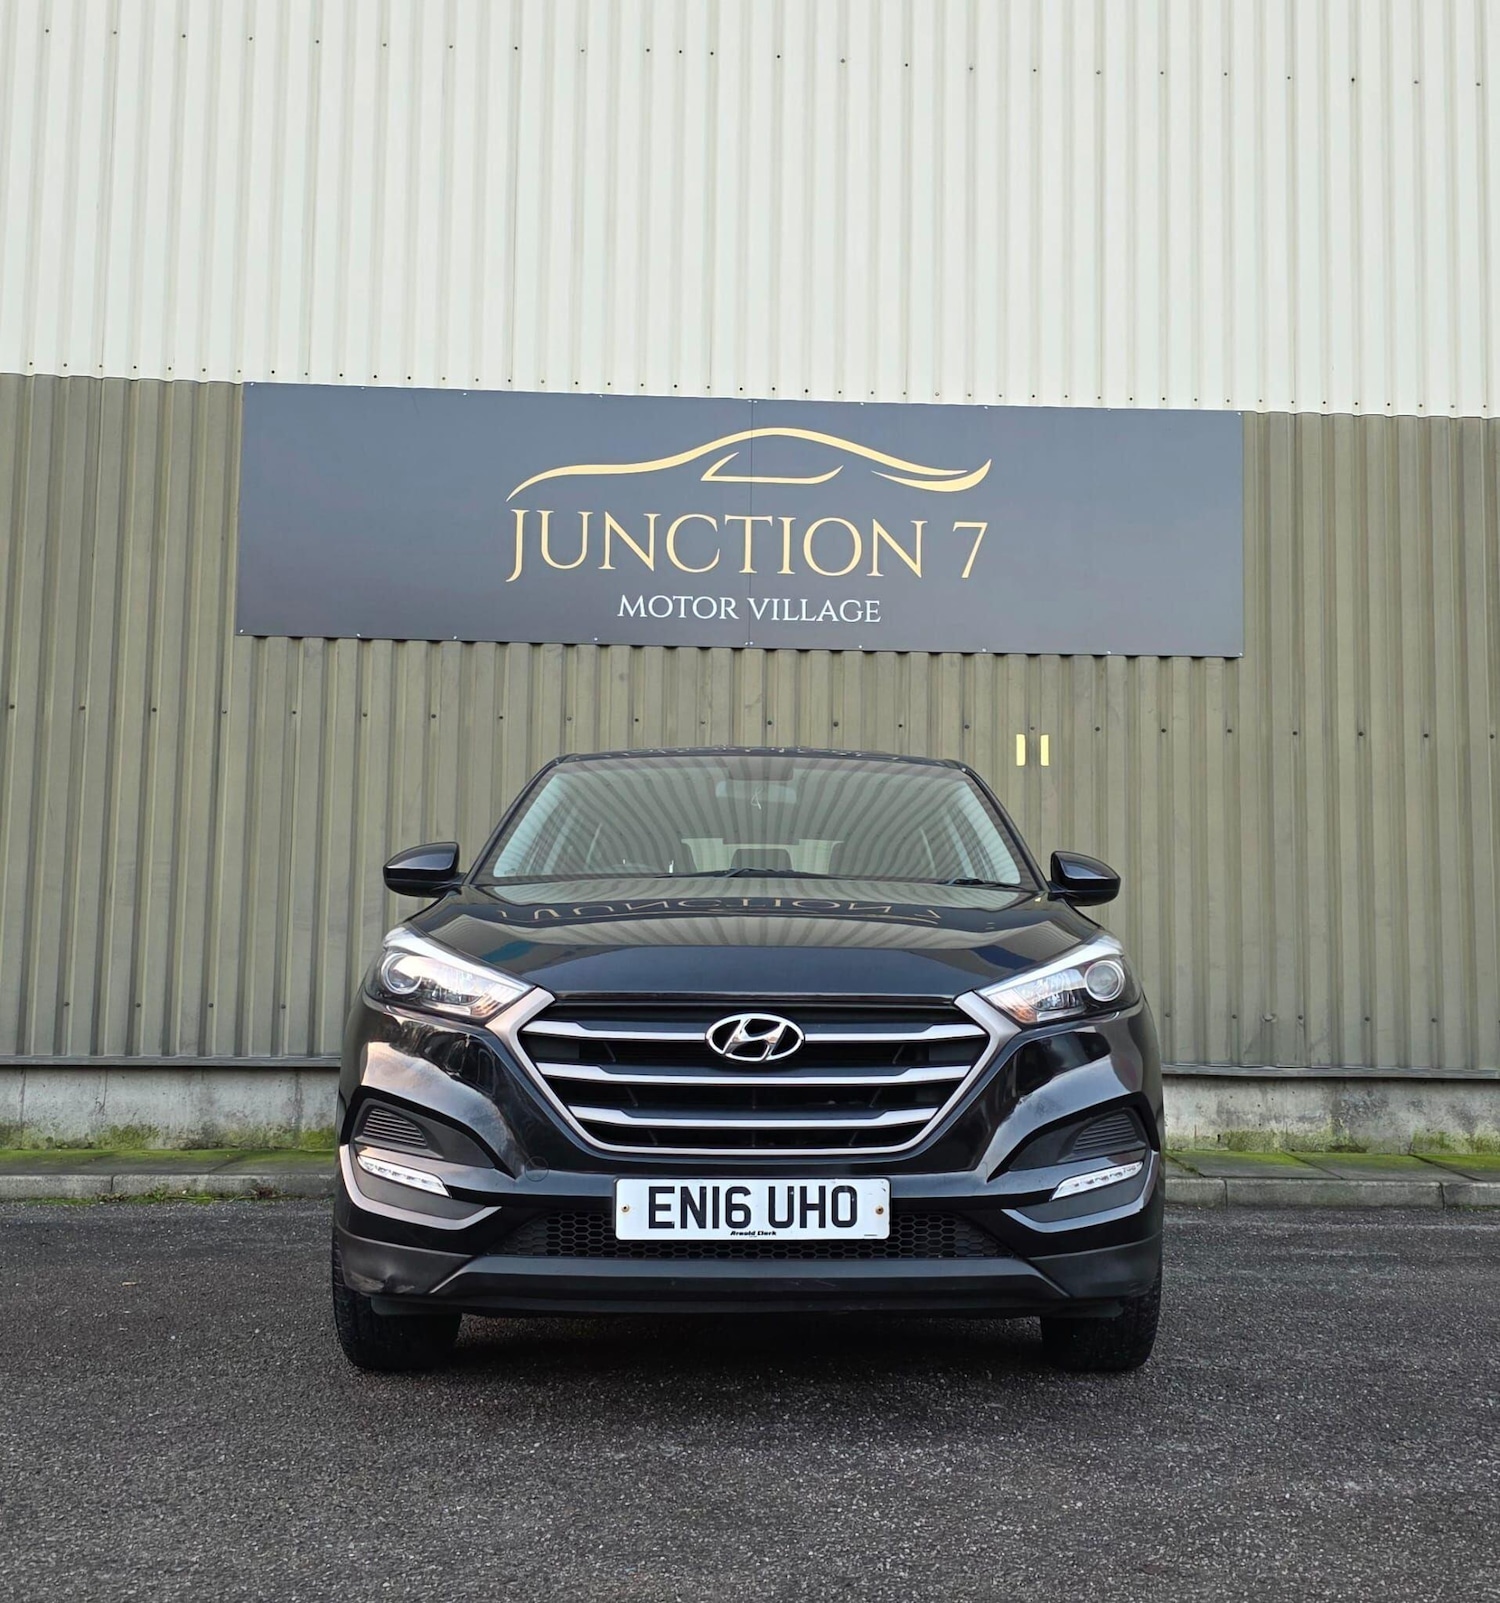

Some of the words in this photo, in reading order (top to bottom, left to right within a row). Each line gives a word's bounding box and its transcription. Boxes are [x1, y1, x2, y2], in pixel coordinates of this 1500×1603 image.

[506, 509, 928, 583] JUNCTION
[952, 521, 988, 579] 7
[617, 594, 739, 620] MOTOR
[746, 597, 881, 623] VILLAGE
[648, 1185, 752, 1230] EN16
[767, 1185, 858, 1229] UHO
